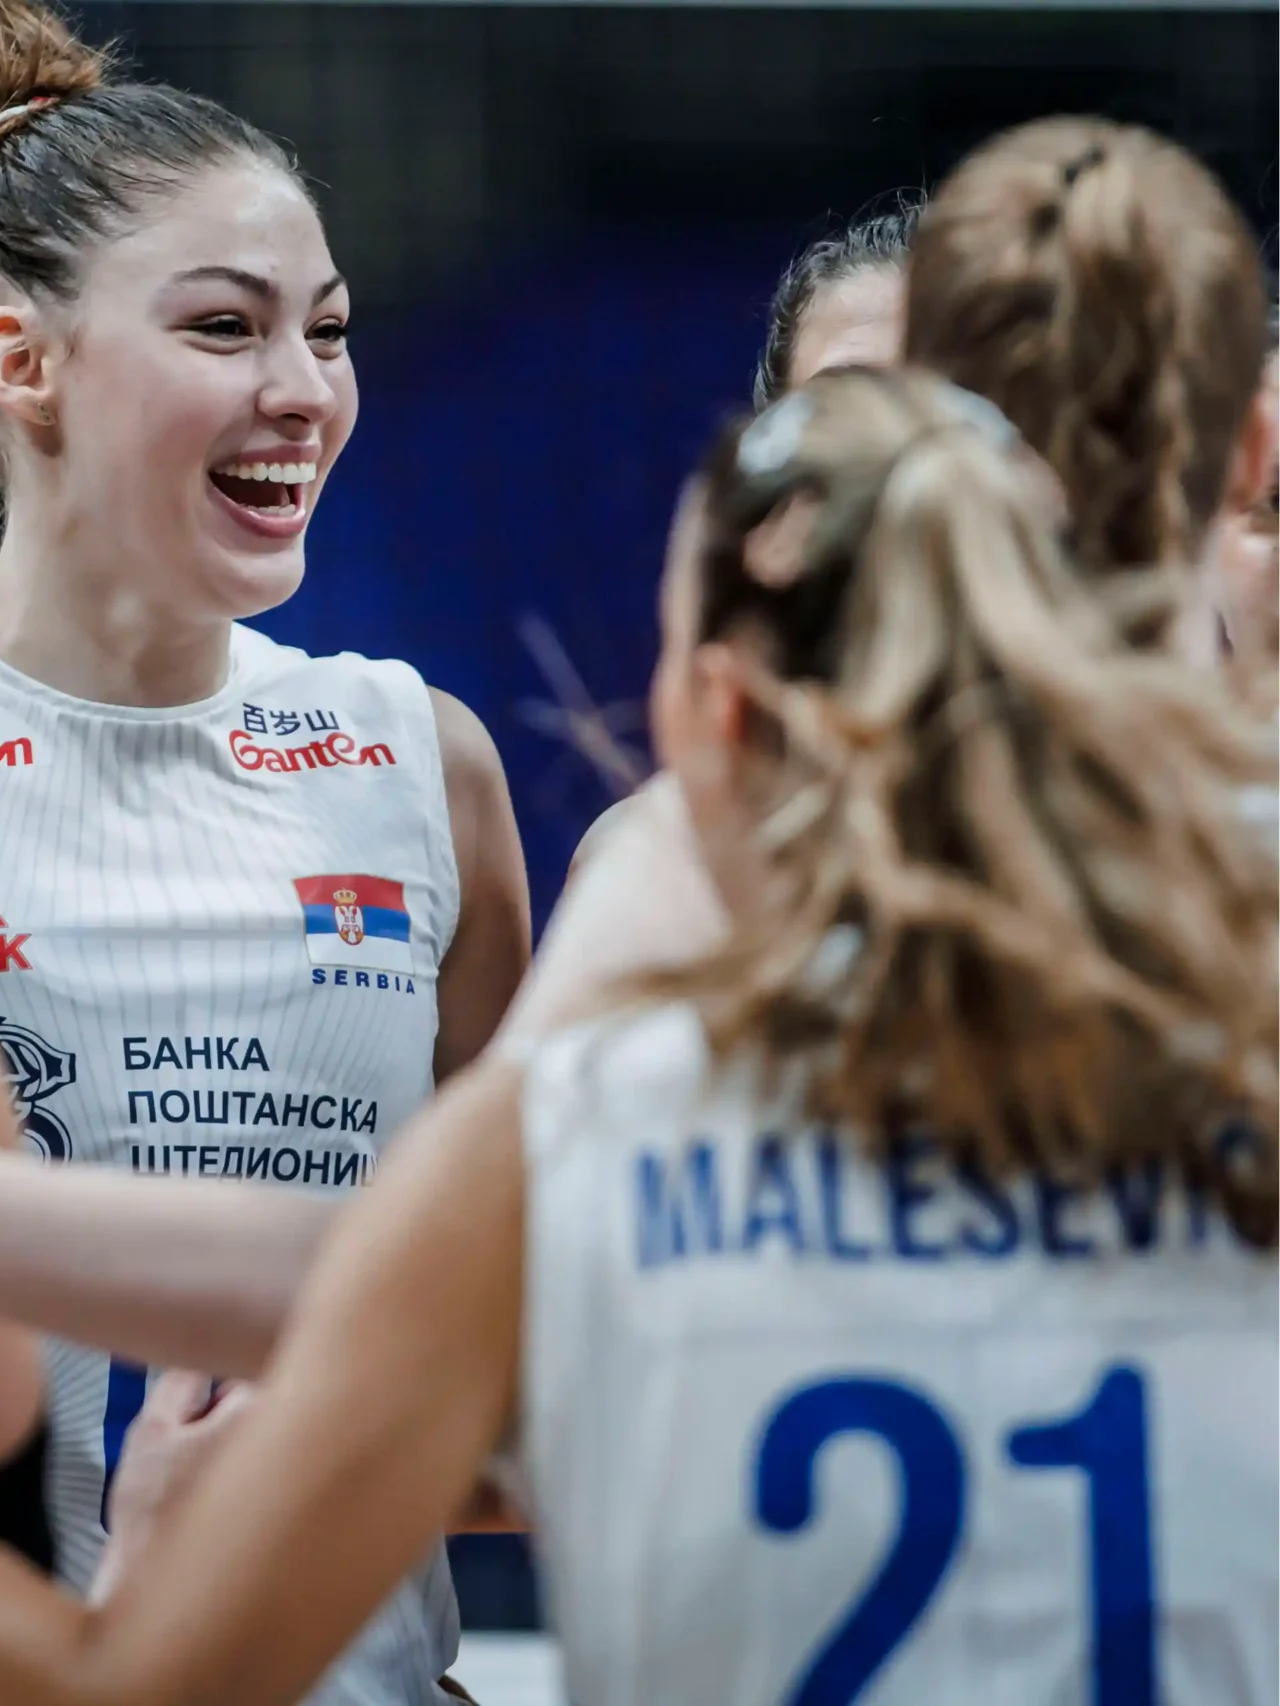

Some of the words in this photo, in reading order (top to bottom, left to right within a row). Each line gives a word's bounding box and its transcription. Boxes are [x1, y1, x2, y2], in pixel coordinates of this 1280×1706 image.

[243, 702, 340, 735] 百岁山
[229, 729, 396, 772] Ganten
[312, 968, 415, 995] SERBIA
[123, 1037, 270, 1071] БАНКА
[128, 1090, 377, 1133] ПОШТАНСКА
[756, 1362, 1157, 1706] 21
